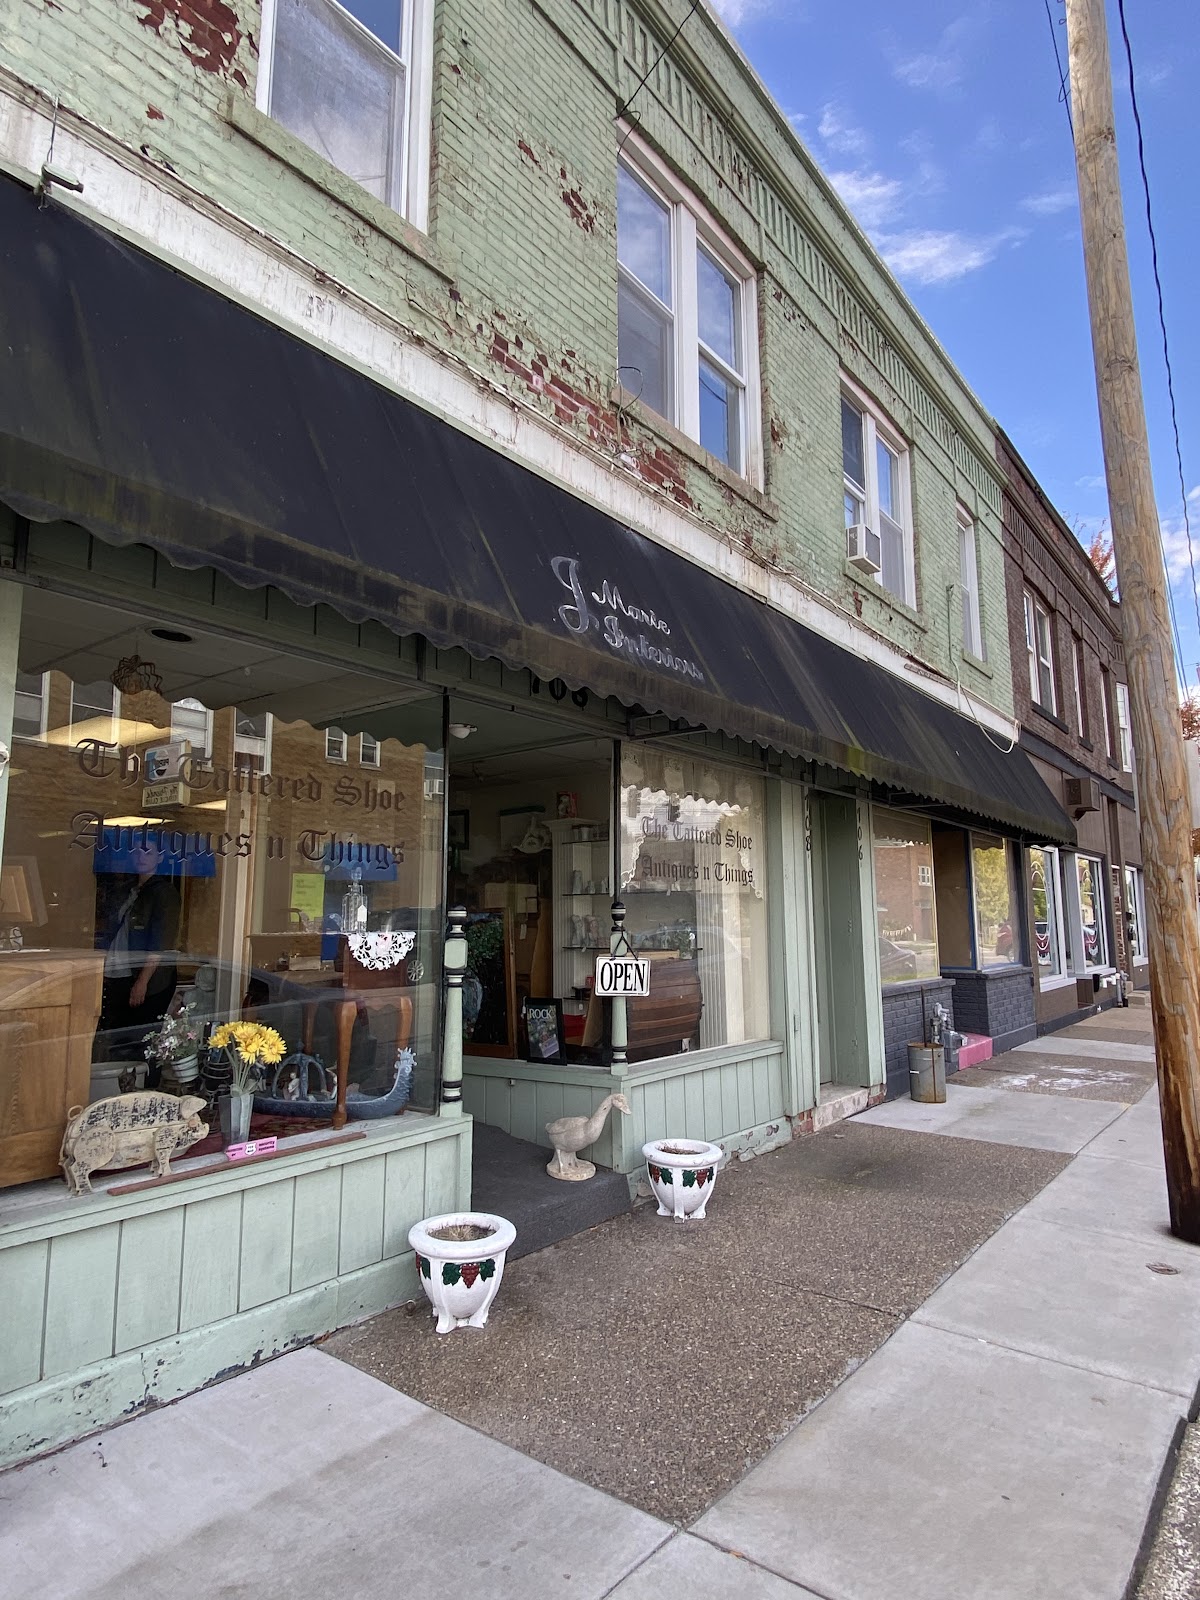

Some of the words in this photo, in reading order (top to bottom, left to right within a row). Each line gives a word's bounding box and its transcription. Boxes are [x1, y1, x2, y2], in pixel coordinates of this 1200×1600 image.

[75, 738, 161, 789] The
[177, 752, 323, 803] Tattered
[333, 775, 406, 815] Shoe
[69, 810, 254, 863] Antiques
[267, 834, 287, 861] n
[298, 829, 406, 869] Things
[641, 816, 668, 841] The
[672, 821, 722, 846] Tattered
[725, 829, 752, 851] Shoe
[641, 855, 699, 881] Antiques
[714, 861, 754, 886] Things
[600, 962, 645, 992] OPEN
[528, 1008, 552, 1020] ROCK
